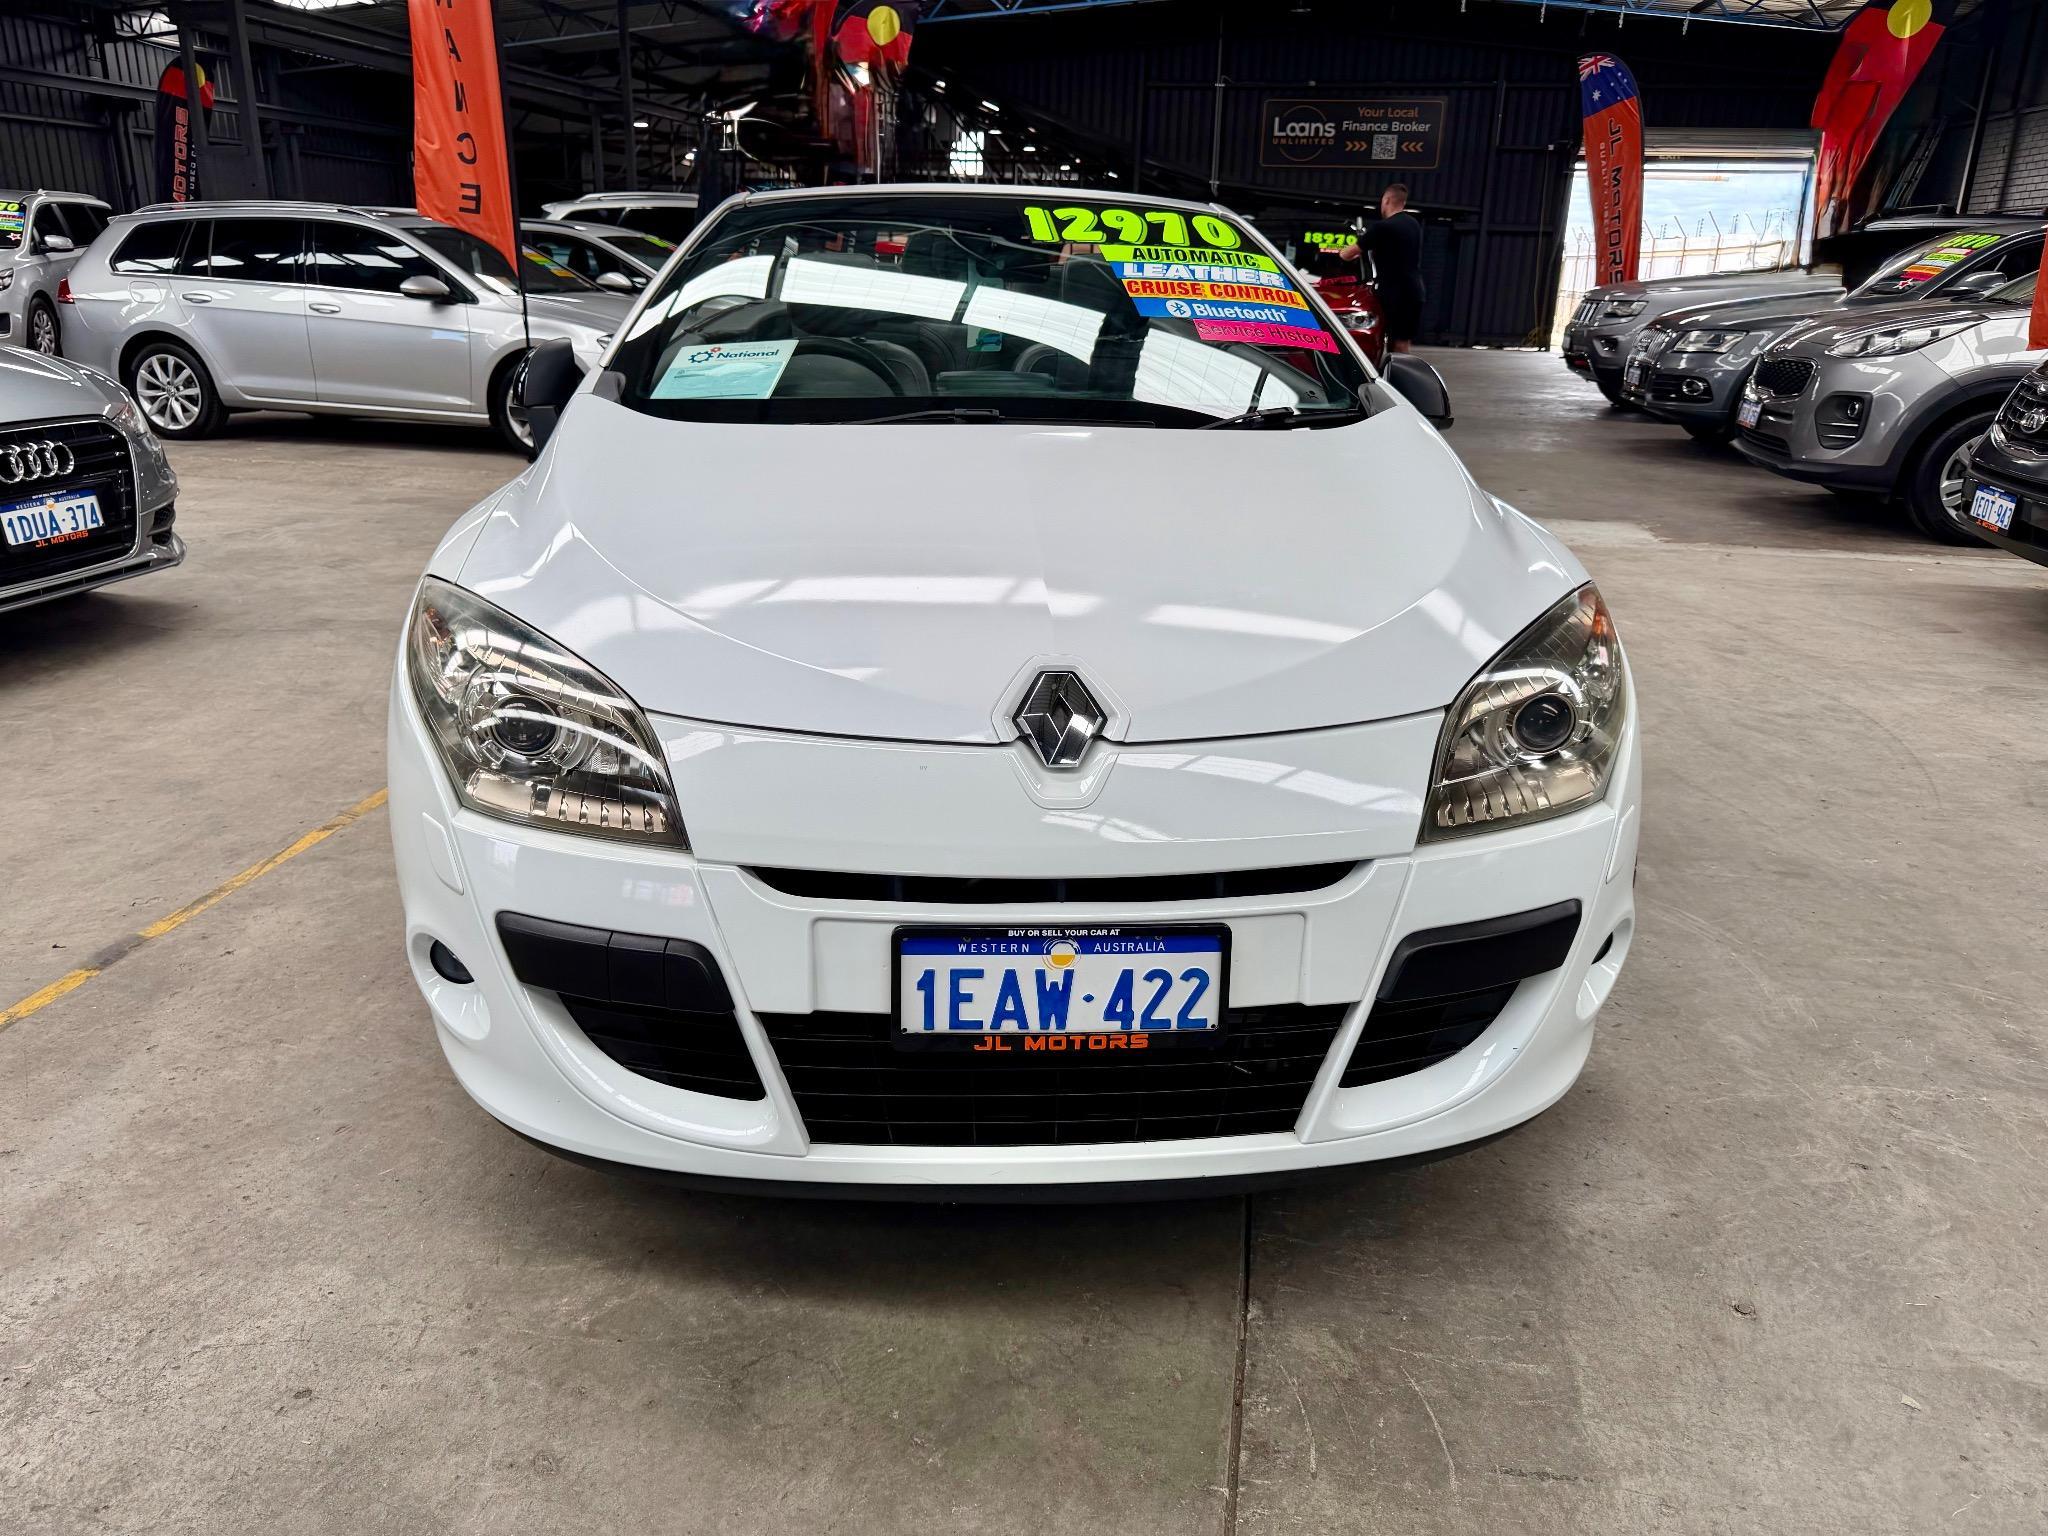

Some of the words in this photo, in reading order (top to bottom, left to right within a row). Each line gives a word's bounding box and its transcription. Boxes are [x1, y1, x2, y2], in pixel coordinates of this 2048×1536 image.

[1358, 106, 1383, 118] Your
[1388, 107, 1419, 118] Local
[1273, 116, 1336, 137] Loans
[1342, 120, 1388, 132] Finance
[1391, 121, 1431, 132] Broker
[1272, 136, 1335, 146] UNLIMITED
[1608, 118, 1623, 156] JL
[1023, 206, 1241, 249] 12970
[1132, 248, 1259, 268] AUTOMATIC
[1122, 263, 1284, 288] LEATHER
[1126, 280, 1202, 298] CRUISE
[1210, 283, 1303, 308] CONTROL
[1195, 303, 1287, 323] Bluetooth
[1196, 322, 1266, 340] Service
[1269, 326, 1330, 349] History
[716, 349, 780, 359] National
[35, 539, 49, 548] JL
[50, 530, 89, 545] MOTORS
[958, 943, 1030, 953] WESTERN
[1094, 942, 1165, 952] AUSTRALIA
[974, 1035, 1011, 1051] JL
[1024, 1034, 1149, 1050] MOTORS
